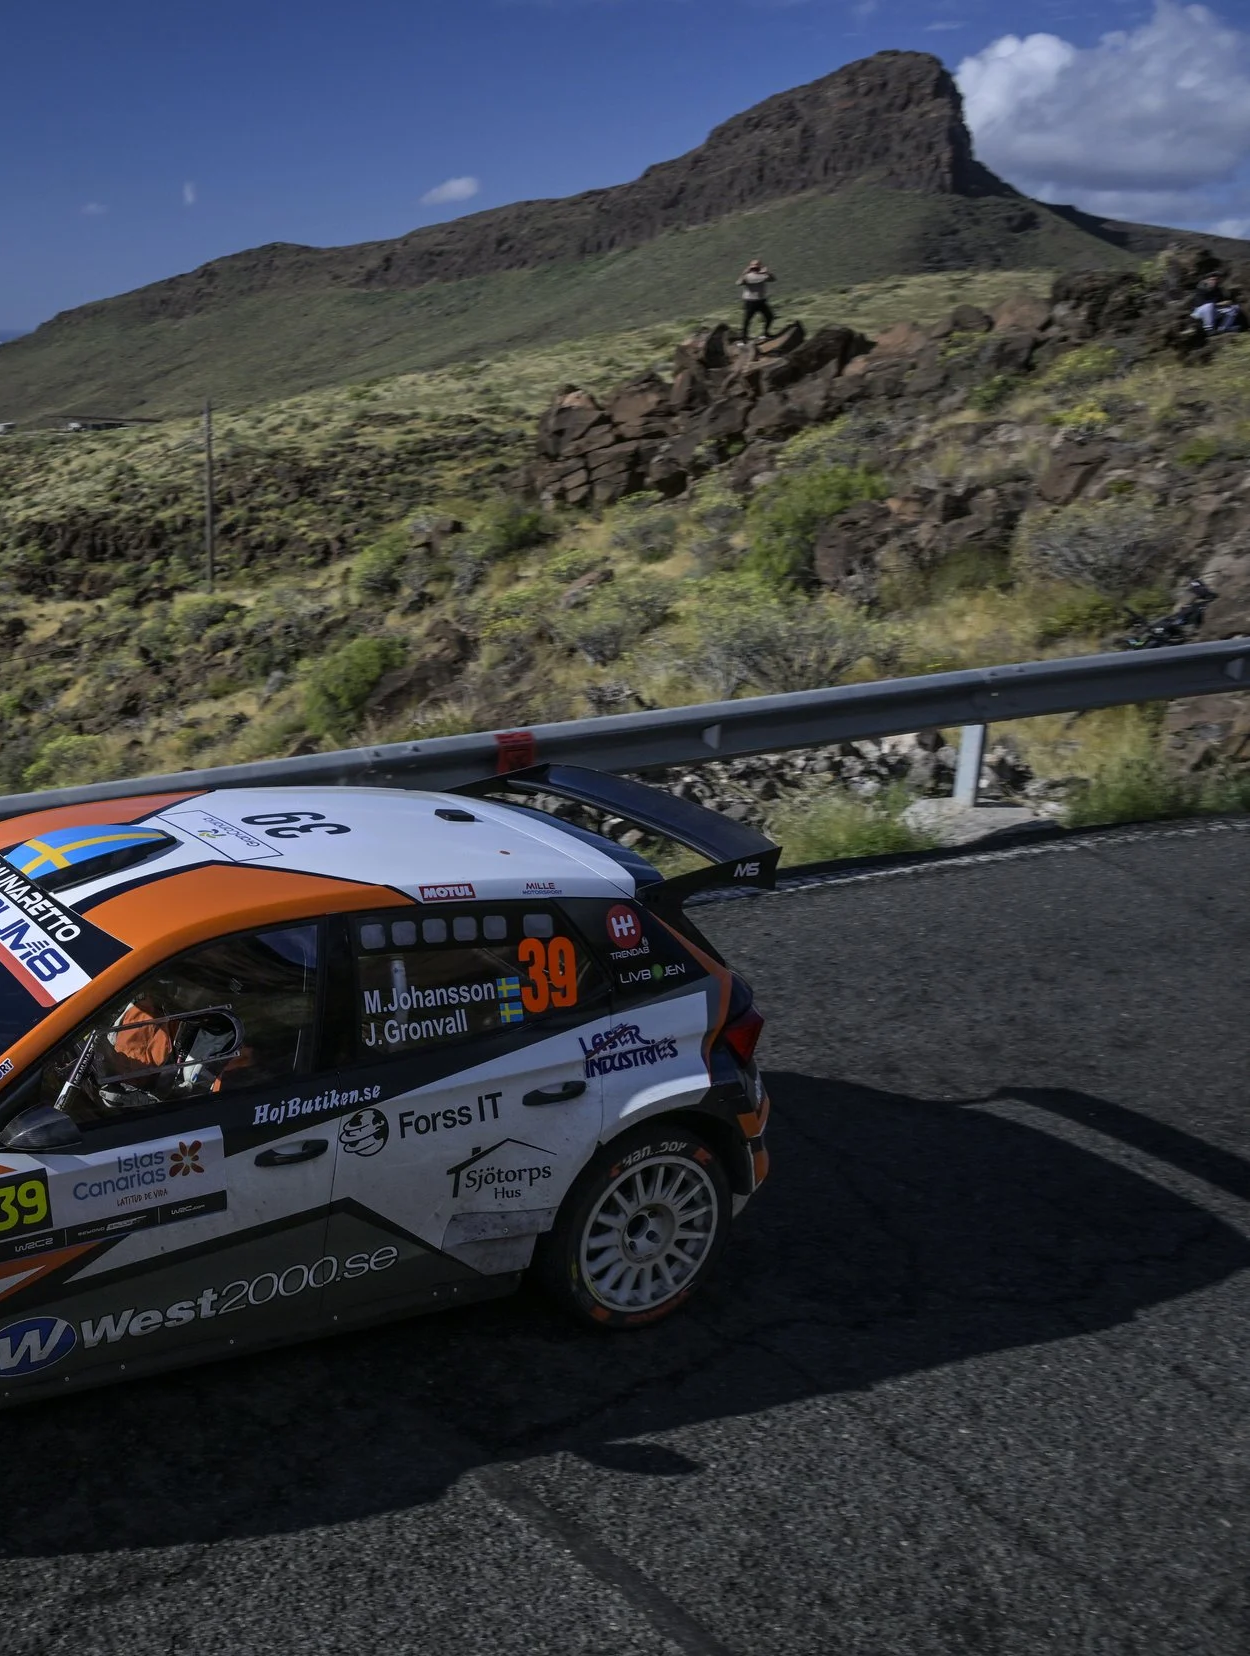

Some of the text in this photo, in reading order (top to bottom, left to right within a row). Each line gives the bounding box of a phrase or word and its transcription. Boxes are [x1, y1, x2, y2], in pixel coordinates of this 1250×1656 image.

[240, 811, 352, 839] 39
[733, 862, 761, 878] MS
[423, 886, 473, 899] MOTUL
[526, 882, 556, 890] MILLE
[517, 936, 578, 1013] 39
[399, 1091, 503, 1139] Forss IT
[117, 1151, 165, 1174] Islas
[73, 1168, 167, 1201] Canarias
[465, 1165, 552, 1193] Sjötorps
[144, 1192, 152, 1201] DE
[153, 1188, 168, 1199] VIDA
[494, 1186, 522, 1200] Hus
[78, 1245, 399, 1349] West2000.se
